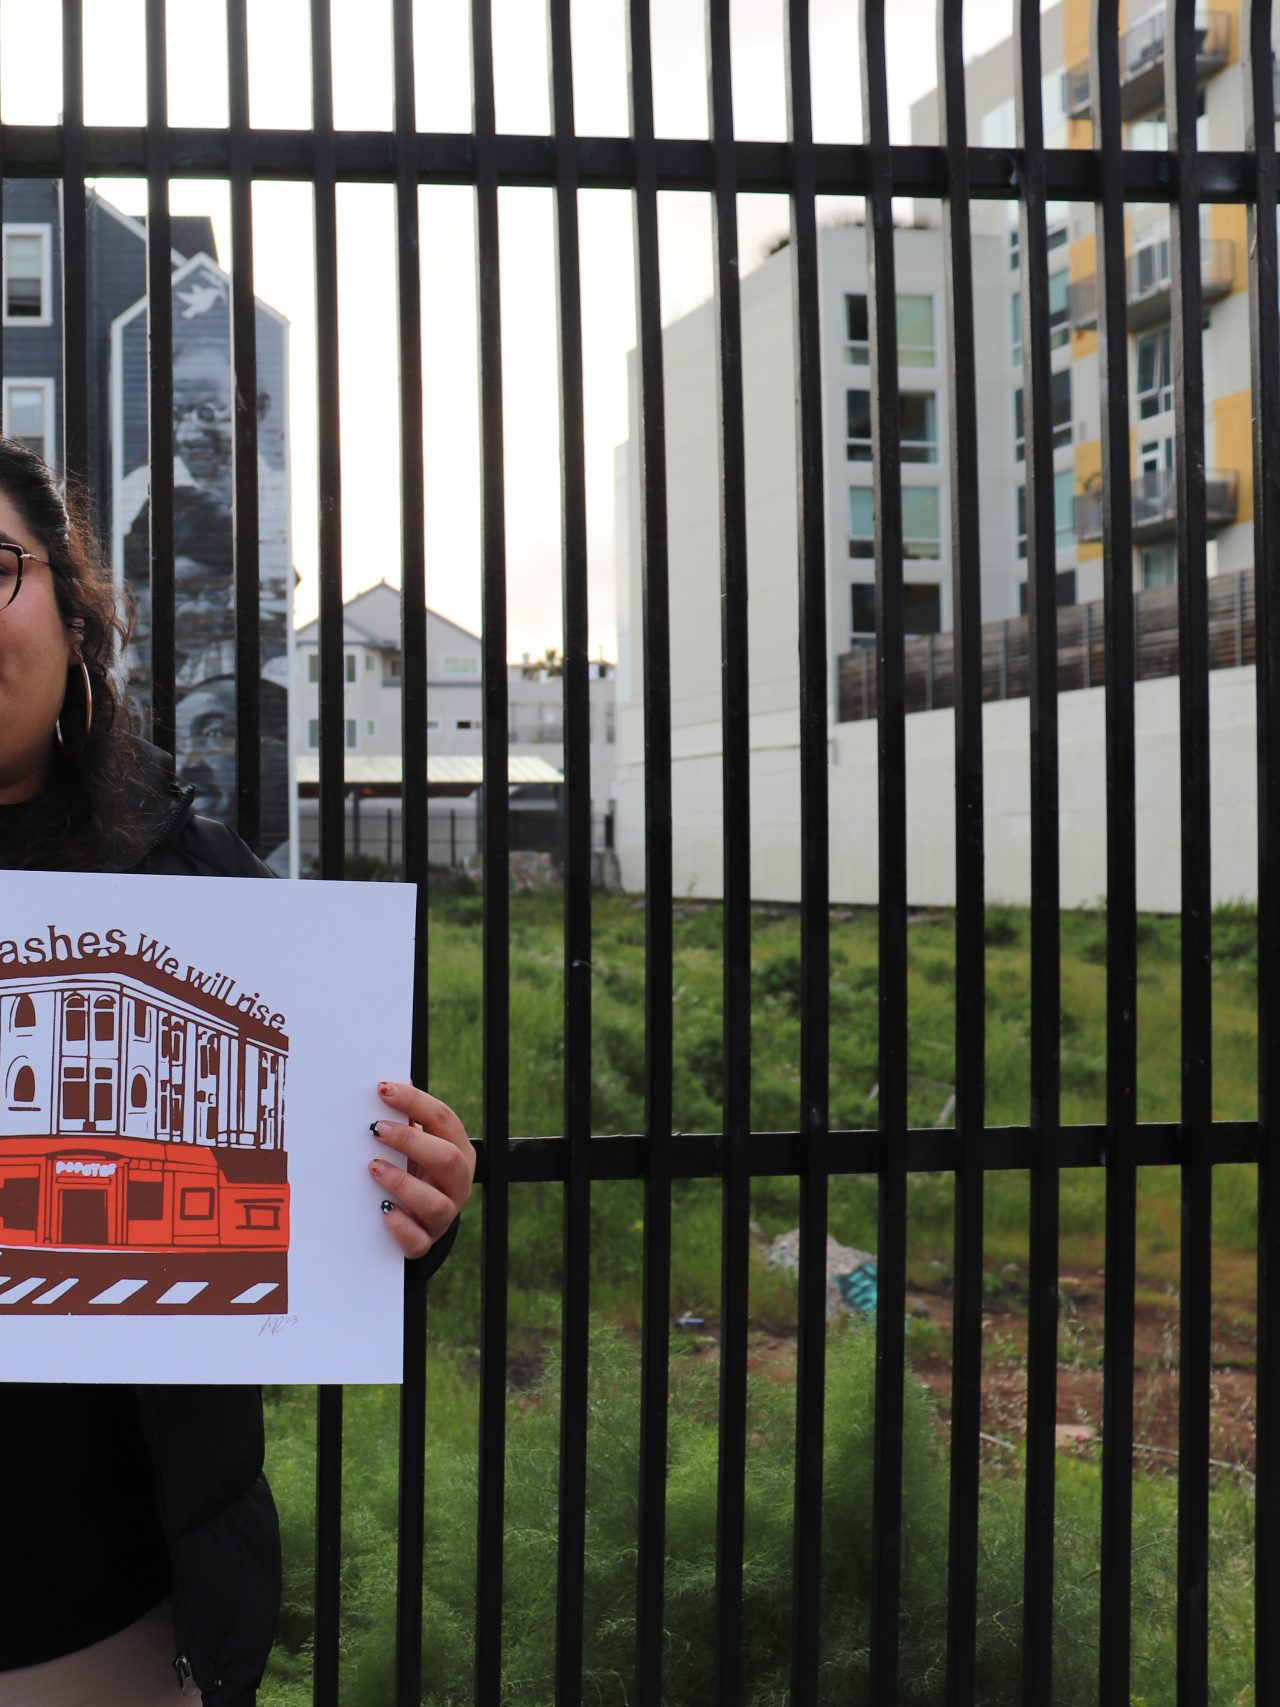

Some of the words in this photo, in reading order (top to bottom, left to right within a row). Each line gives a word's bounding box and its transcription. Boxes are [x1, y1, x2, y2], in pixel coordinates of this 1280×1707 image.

[138, 933, 179, 975] We
[186, 966, 236, 1004] will
[238, 993, 286, 1030] rise
